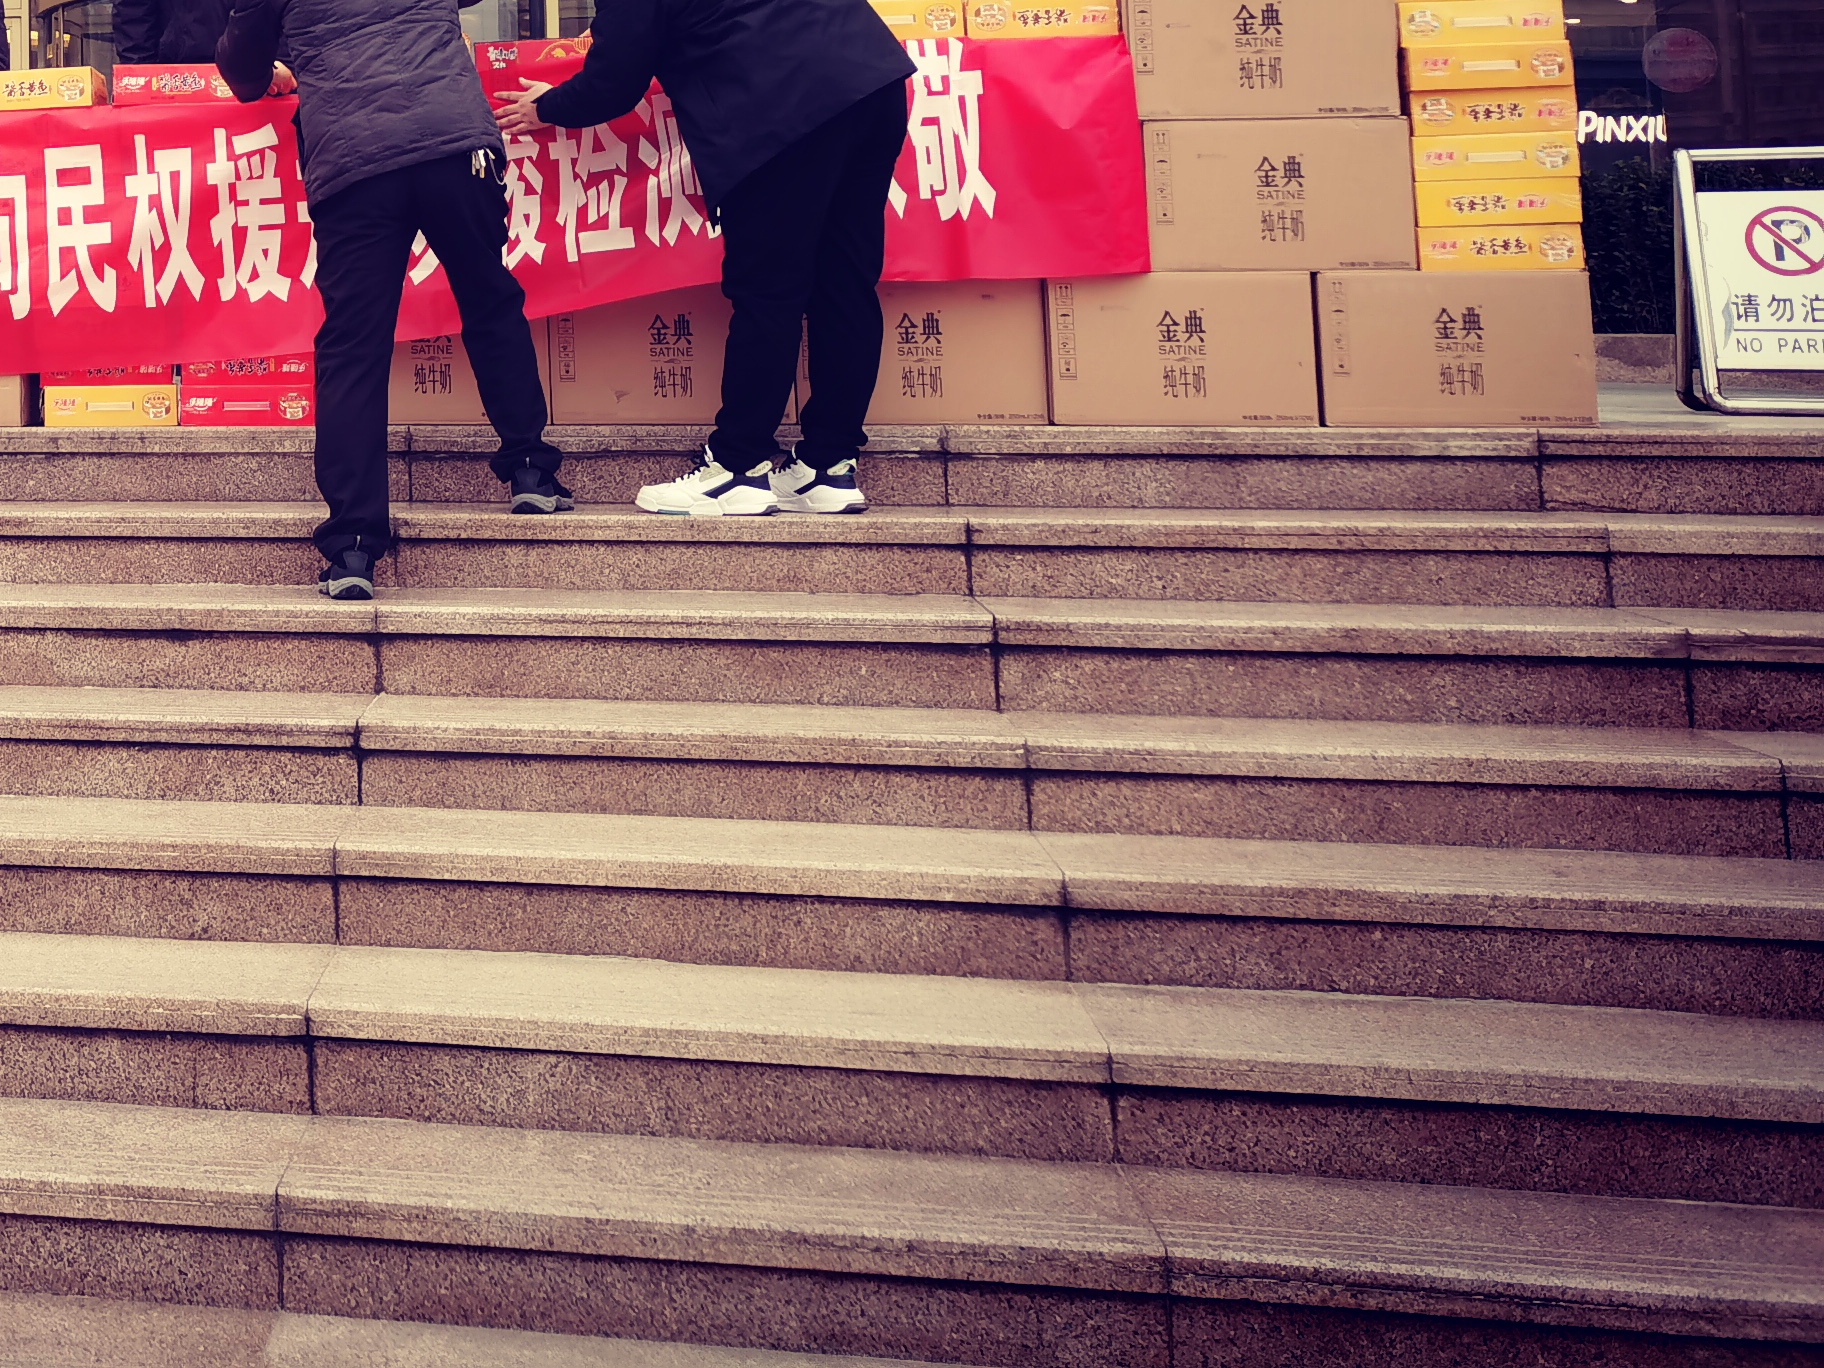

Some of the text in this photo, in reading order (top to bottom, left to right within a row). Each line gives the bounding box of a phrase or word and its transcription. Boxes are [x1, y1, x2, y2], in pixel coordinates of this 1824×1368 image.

[1233, 3, 1284, 35] 金典
[1234, 37, 1284, 48] SATINE
[1239, 56, 1283, 89] 纯牛奶
[1254, 156, 1306, 188] 金典
[1256, 190, 1306, 200] SATINE
[1261, 210, 1305, 242] 纯牛奶
[1434, 307, 1485, 340] 金典
[1731, 293, 1824, 323] 请勿泊
[647, 314, 694, 346] 金典
[895, 312, 943, 344] 金典
[1156, 310, 1207, 343] 金典
[410, 345, 453, 355] SATINE
[649, 346, 693, 357] SATINE
[897, 346, 943, 356] SATINE
[1158, 345, 1207, 355] SATINE
[1435, 342, 1485, 353] SATINE
[1736, 337, 1824, 353] NO PAR
[414, 363, 452, 394] 纯牛奶
[653, 366, 693, 398] 纯牛奶
[902, 365, 943, 398] 纯牛奶
[1163, 365, 1207, 398] 纯牛奶
[1439, 362, 1485, 396] 纯牛奶
